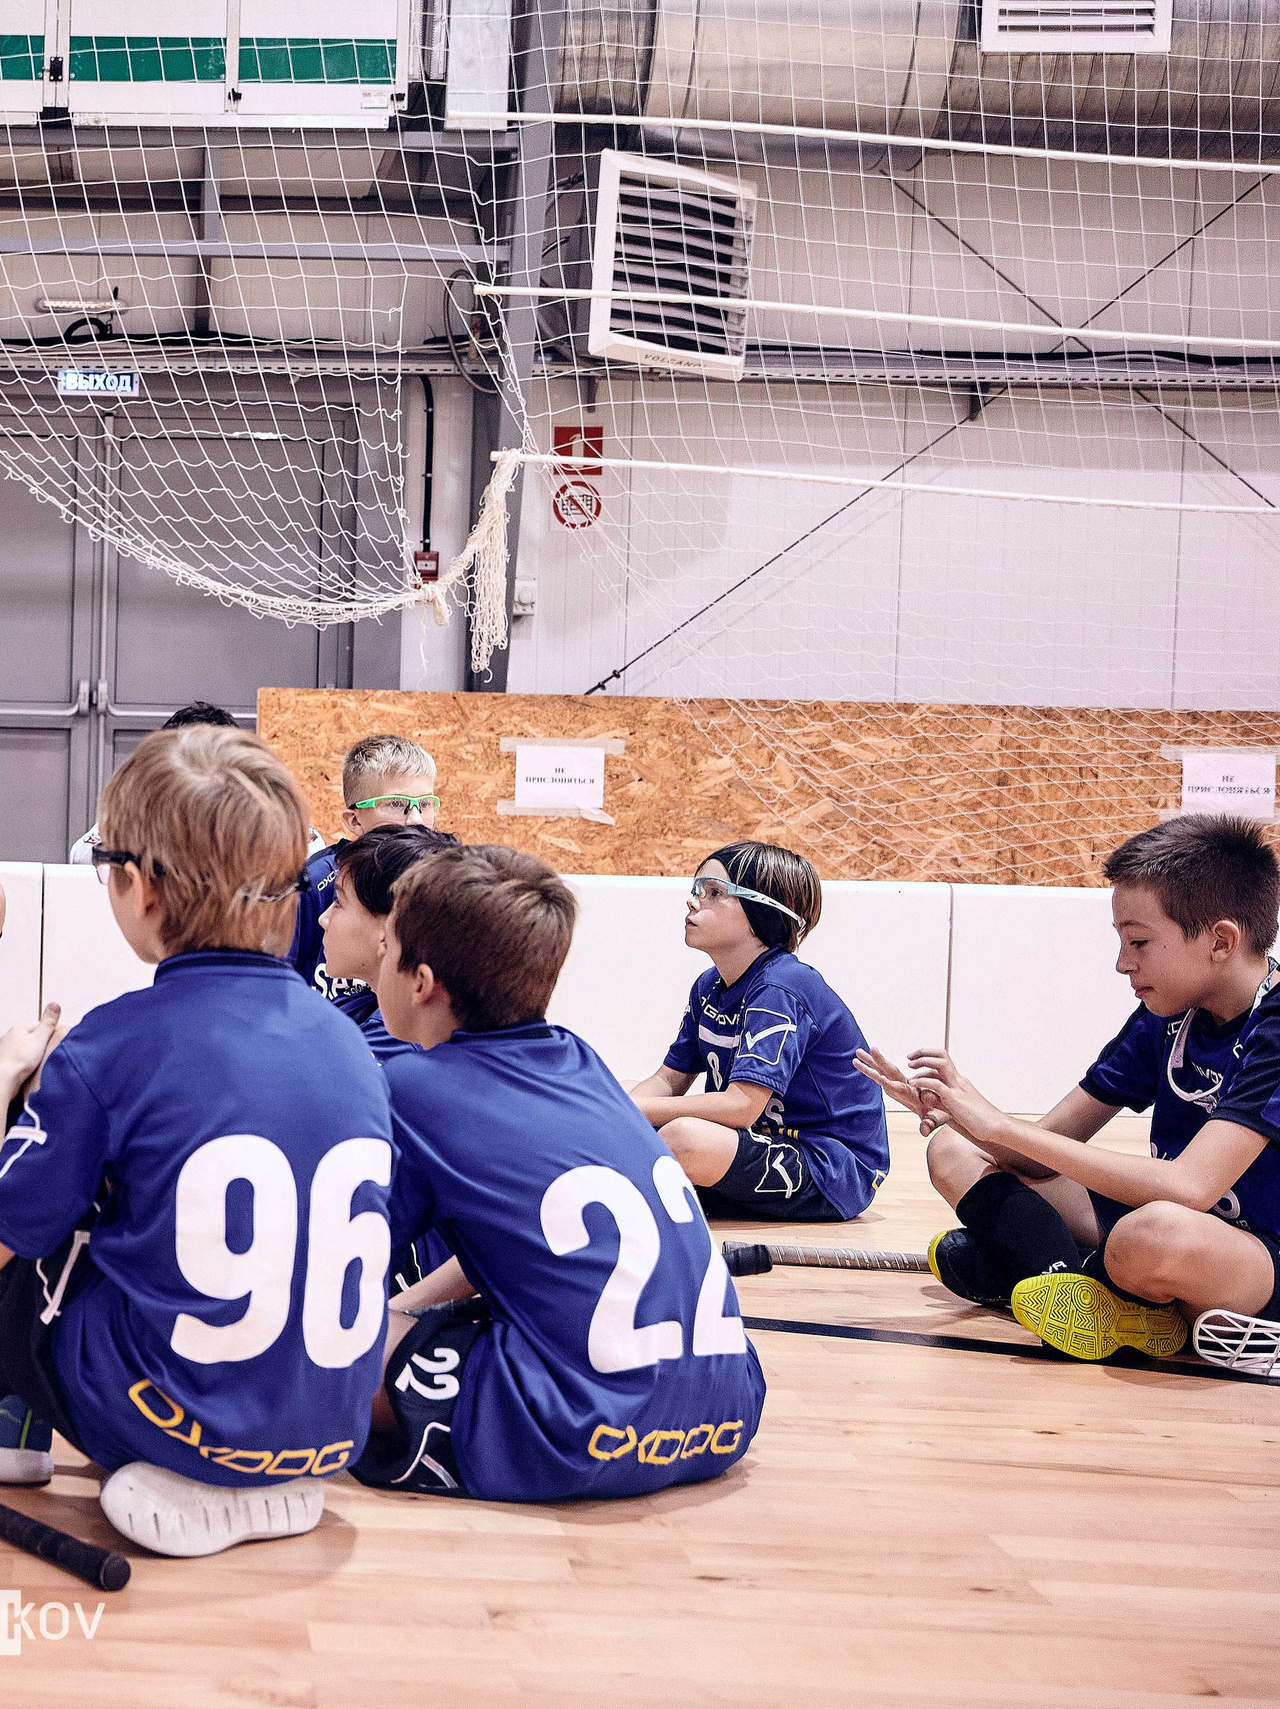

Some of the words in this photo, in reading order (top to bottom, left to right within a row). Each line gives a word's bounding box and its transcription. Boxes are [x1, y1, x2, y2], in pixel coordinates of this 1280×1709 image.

[65, 372, 132, 393] ВЫХОД
[1221, 775, 1234, 783] НЕ
[170, 1134, 392, 1369] 96
[539, 1155, 748, 1374] 22
[128, 1378, 354, 1476] OXDOG
[587, 1420, 744, 1465] OXDOG
